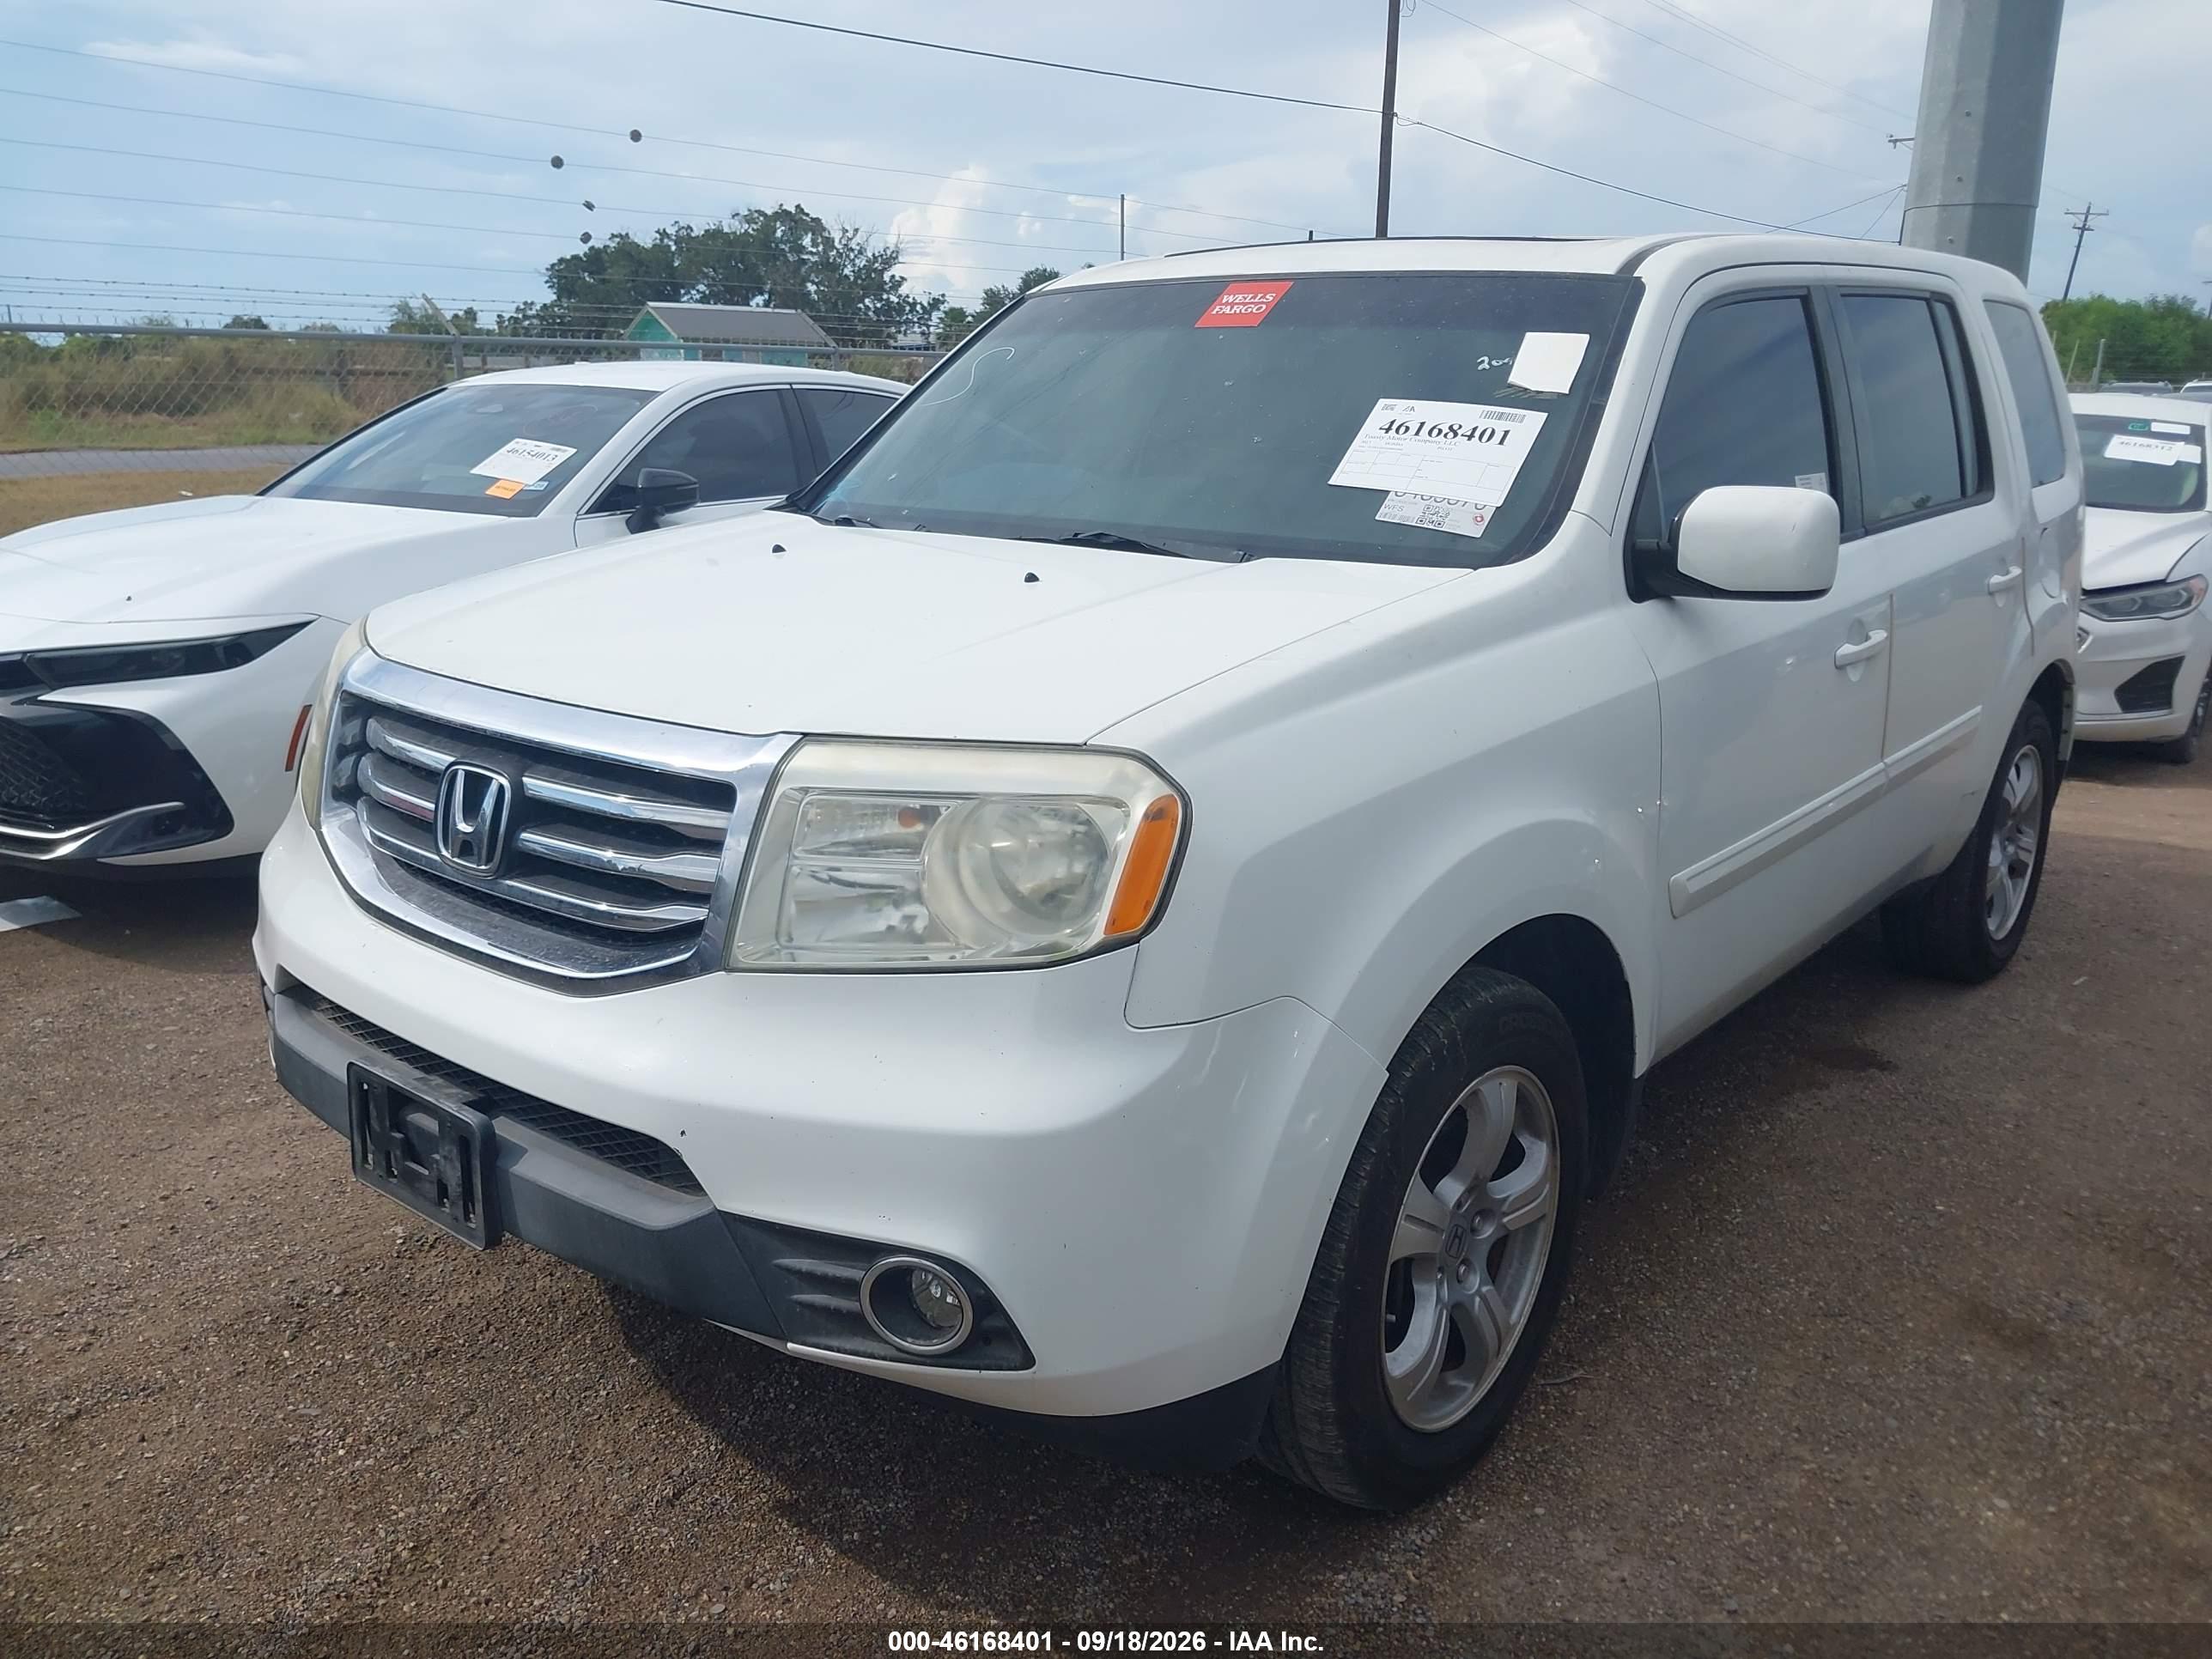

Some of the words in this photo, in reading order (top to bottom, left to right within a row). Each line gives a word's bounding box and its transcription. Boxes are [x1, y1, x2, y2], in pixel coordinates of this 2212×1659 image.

[1222, 293, 1276, 303] WELLS
[1211, 304, 1267, 314] FARGO
[1378, 419, 1511, 446] 46168401
[507, 447, 559, 462] 46154013
[1383, 503, 1405, 513] WFS
